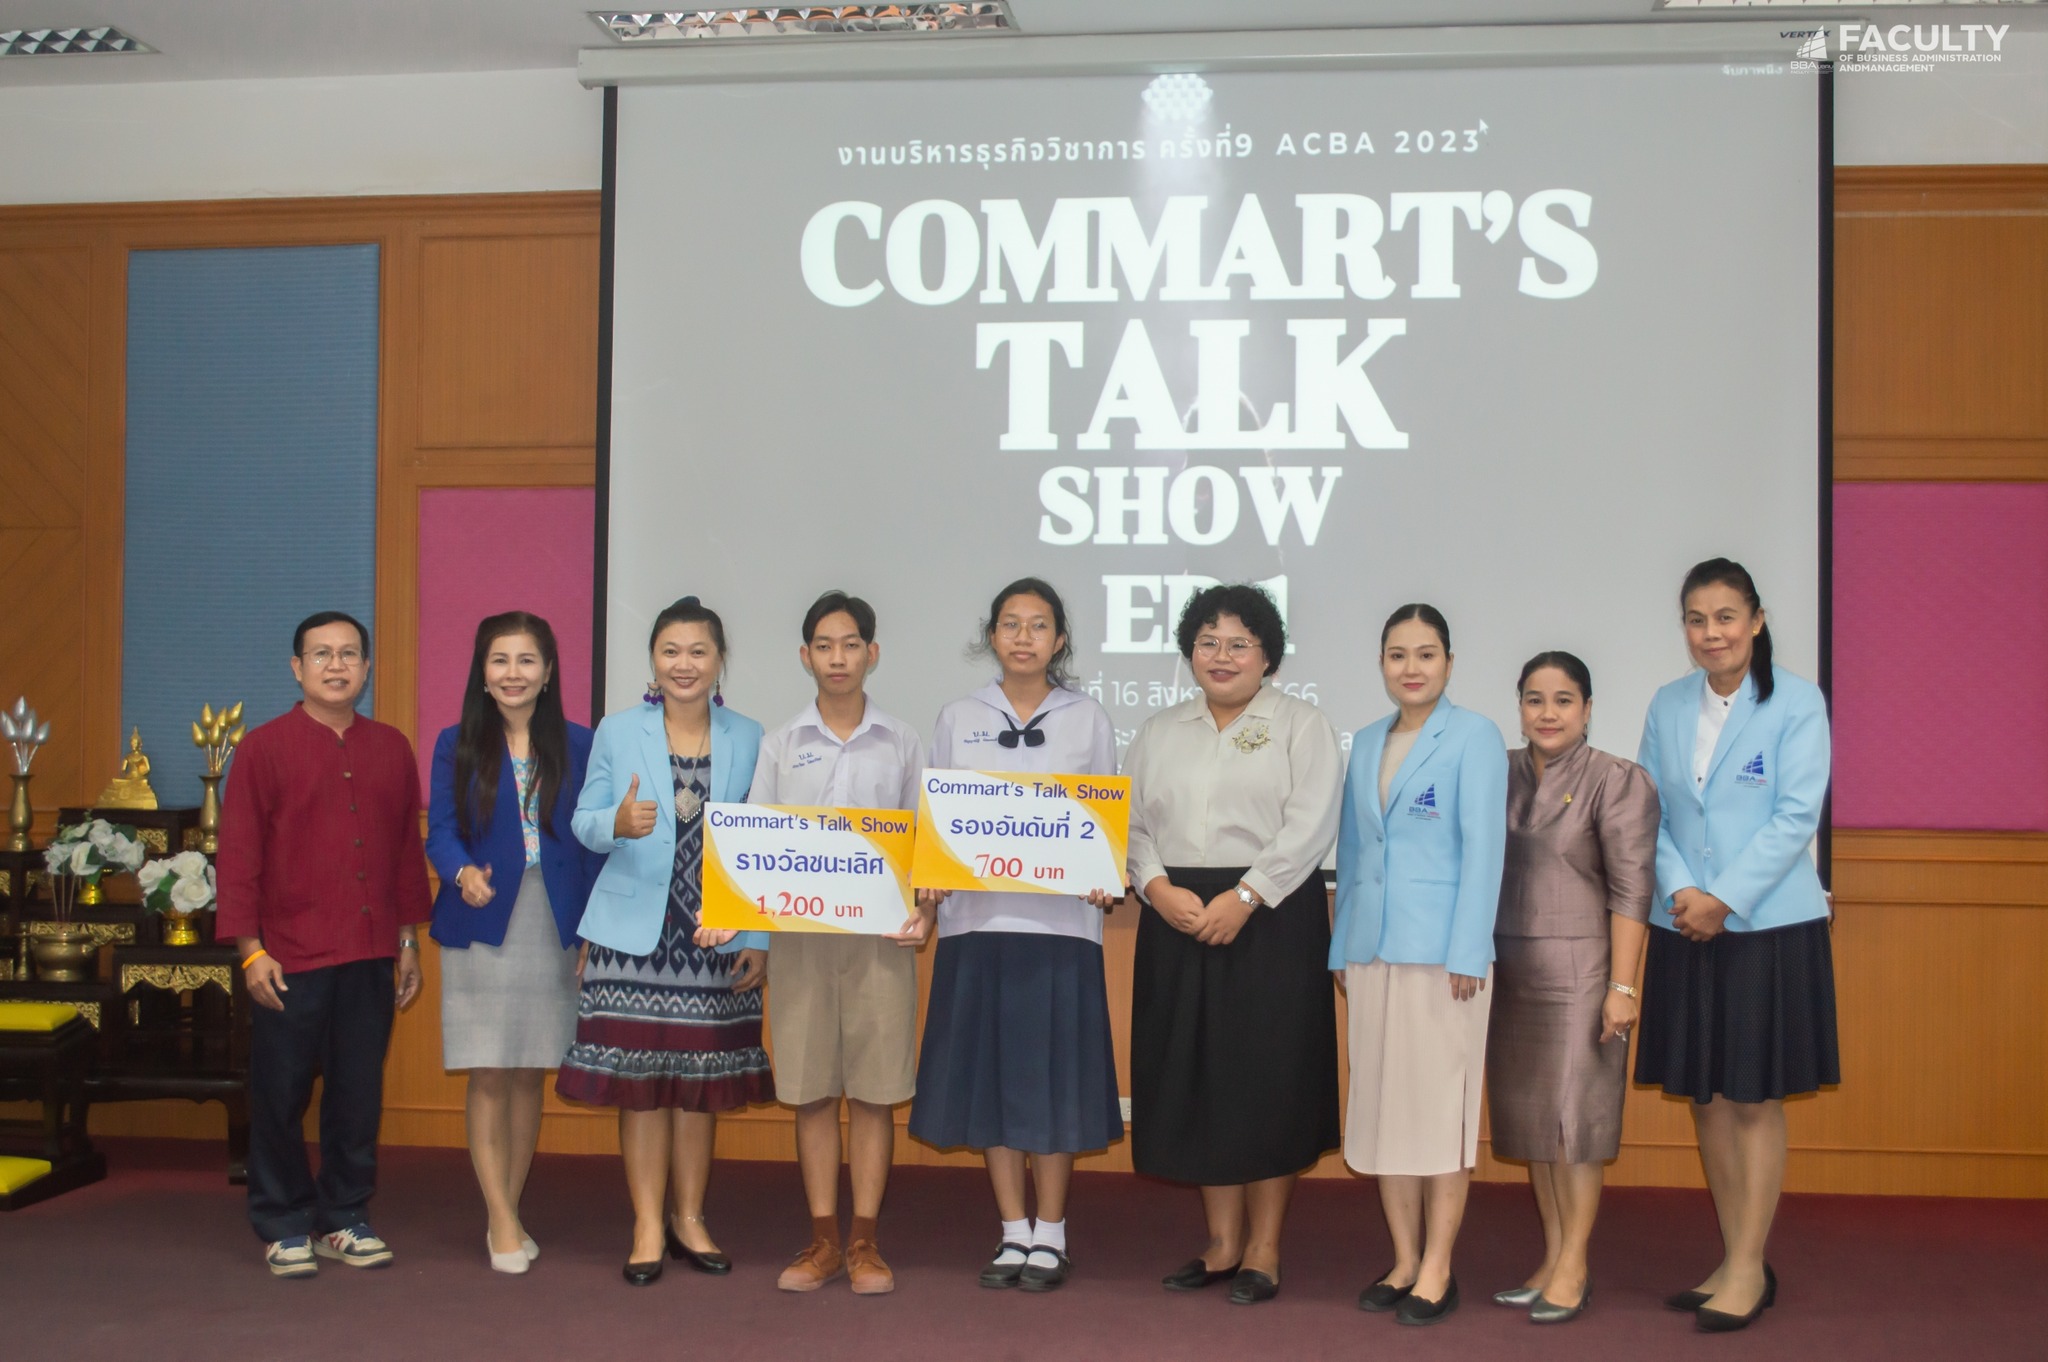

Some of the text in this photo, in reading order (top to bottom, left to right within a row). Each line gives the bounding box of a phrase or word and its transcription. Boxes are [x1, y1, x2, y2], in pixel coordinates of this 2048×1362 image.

[1779, 30, 1831, 38] VERTX
[838, 137, 1146, 170] งานบริหารธุรกิจวิชาการ
[1276, 132, 1374, 156] ACBA
[1394, 129, 1478, 153] 2023
[975, 318, 1410, 451] TALK
[1038, 466, 1343, 546] SHOW
[1112, 681, 1139, 705] 16
[1033, 782, 1068, 799] Talk
[1076, 784, 1125, 800] Show
[817, 815, 853, 832] Talk
[861, 816, 908, 834] Show
[950, 811, 1095, 839] รองอันดับที่ 2
[736, 848, 884, 875] รางวัลชนะเลิศ
[974, 854, 1065, 880] 700 บาท
[756, 891, 863, 919] 1,200 บาท
